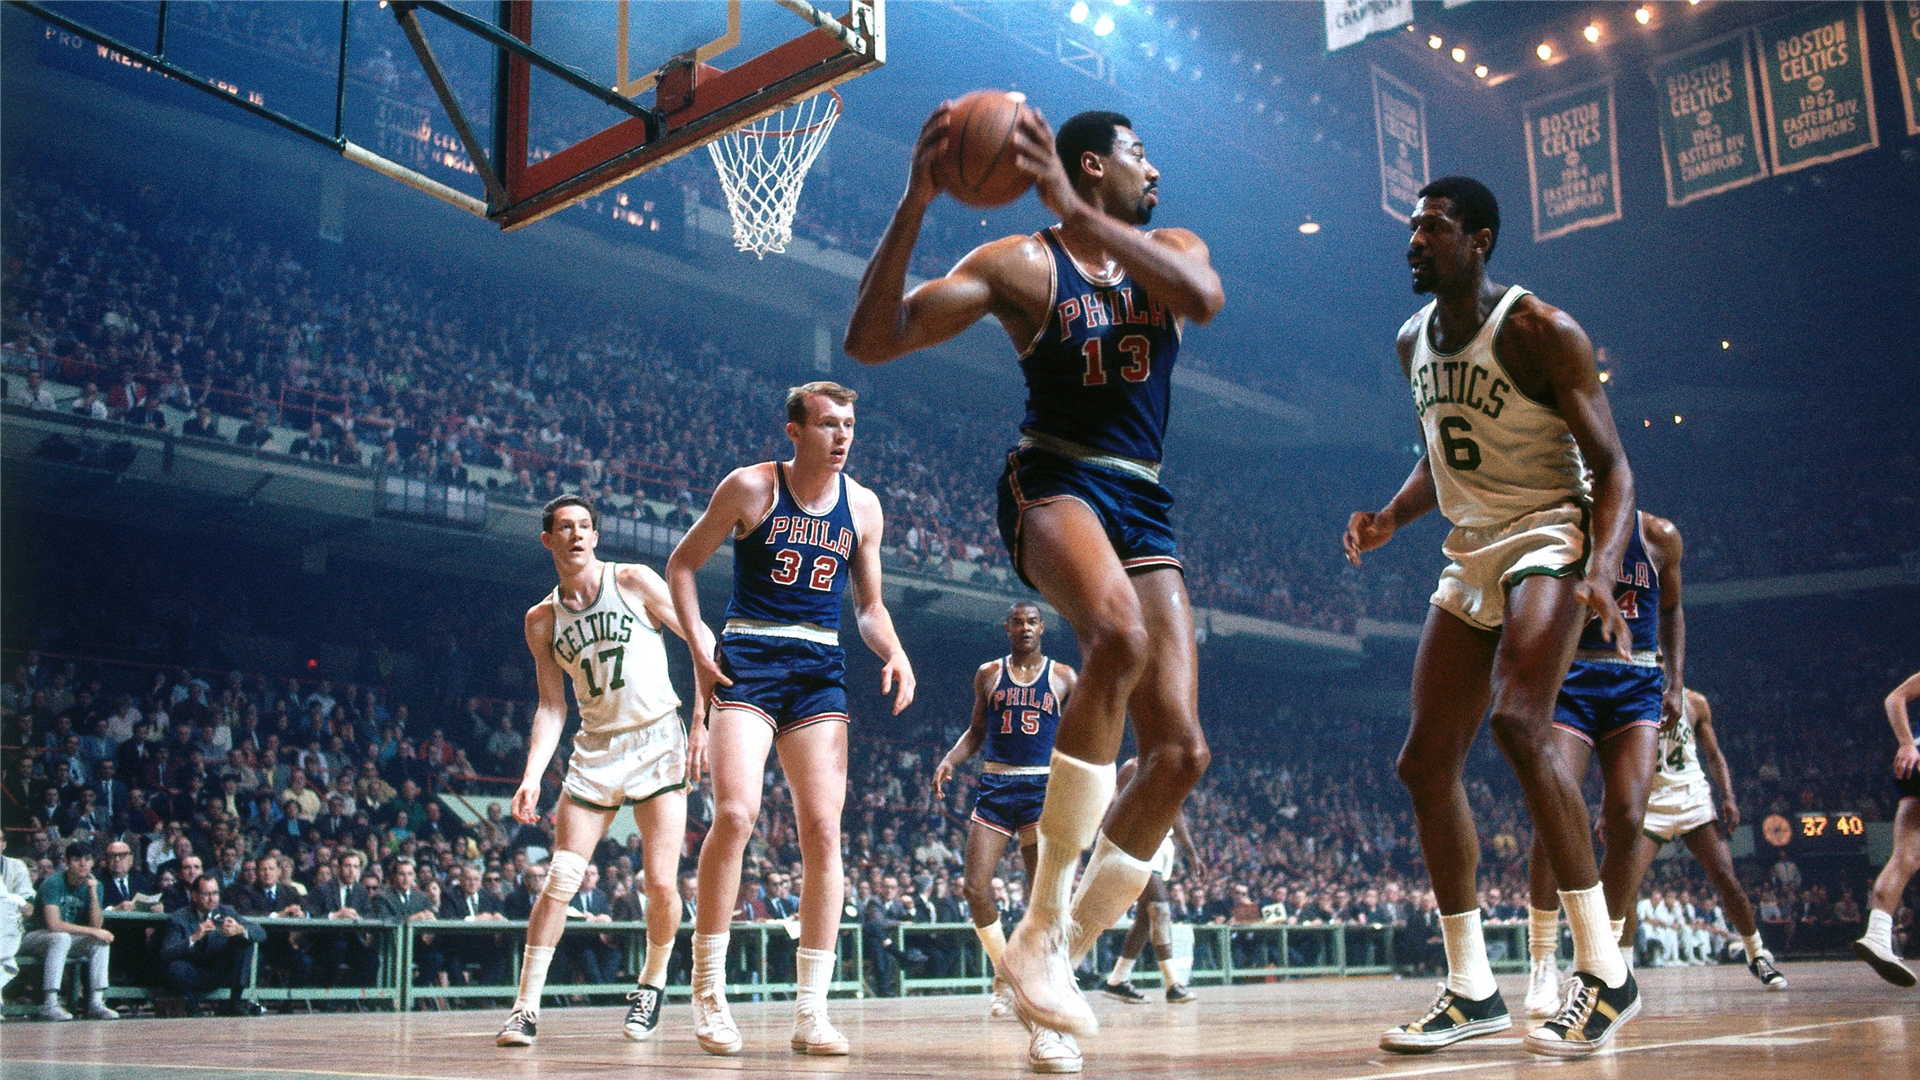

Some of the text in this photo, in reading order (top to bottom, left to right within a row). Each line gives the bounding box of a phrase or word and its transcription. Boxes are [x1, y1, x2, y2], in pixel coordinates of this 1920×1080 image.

[1777, 20, 1846, 61] BOSTON
[1667, 59, 1732, 97] BOSTON
[1780, 43, 1849, 82] CELTICS
[1671, 79, 1733, 118] CELTICS
[1801, 89, 1835, 112] 1962
[1540, 102, 1600, 137] BOSTON
[1783, 107, 1834, 134] EASTERN
[1788, 117, 1856, 149] CHAMPIONS
[1542, 121, 1601, 158] CELTICS
[1057, 287, 1166, 342] PHILA
[1081, 335, 1151, 386] 13
[1412, 361, 1511, 419] CELTICS
[1440, 416, 1482, 471] 6
[765, 516, 853, 560] PHILA
[770, 549, 839, 592] 32
[555, 610, 634, 664] CELTICS
[580, 645, 625, 698] 17
[994, 687, 1054, 715] PHILA
[1000, 710, 1040, 735] 15
[1801, 815, 1864, 837] 37 40
